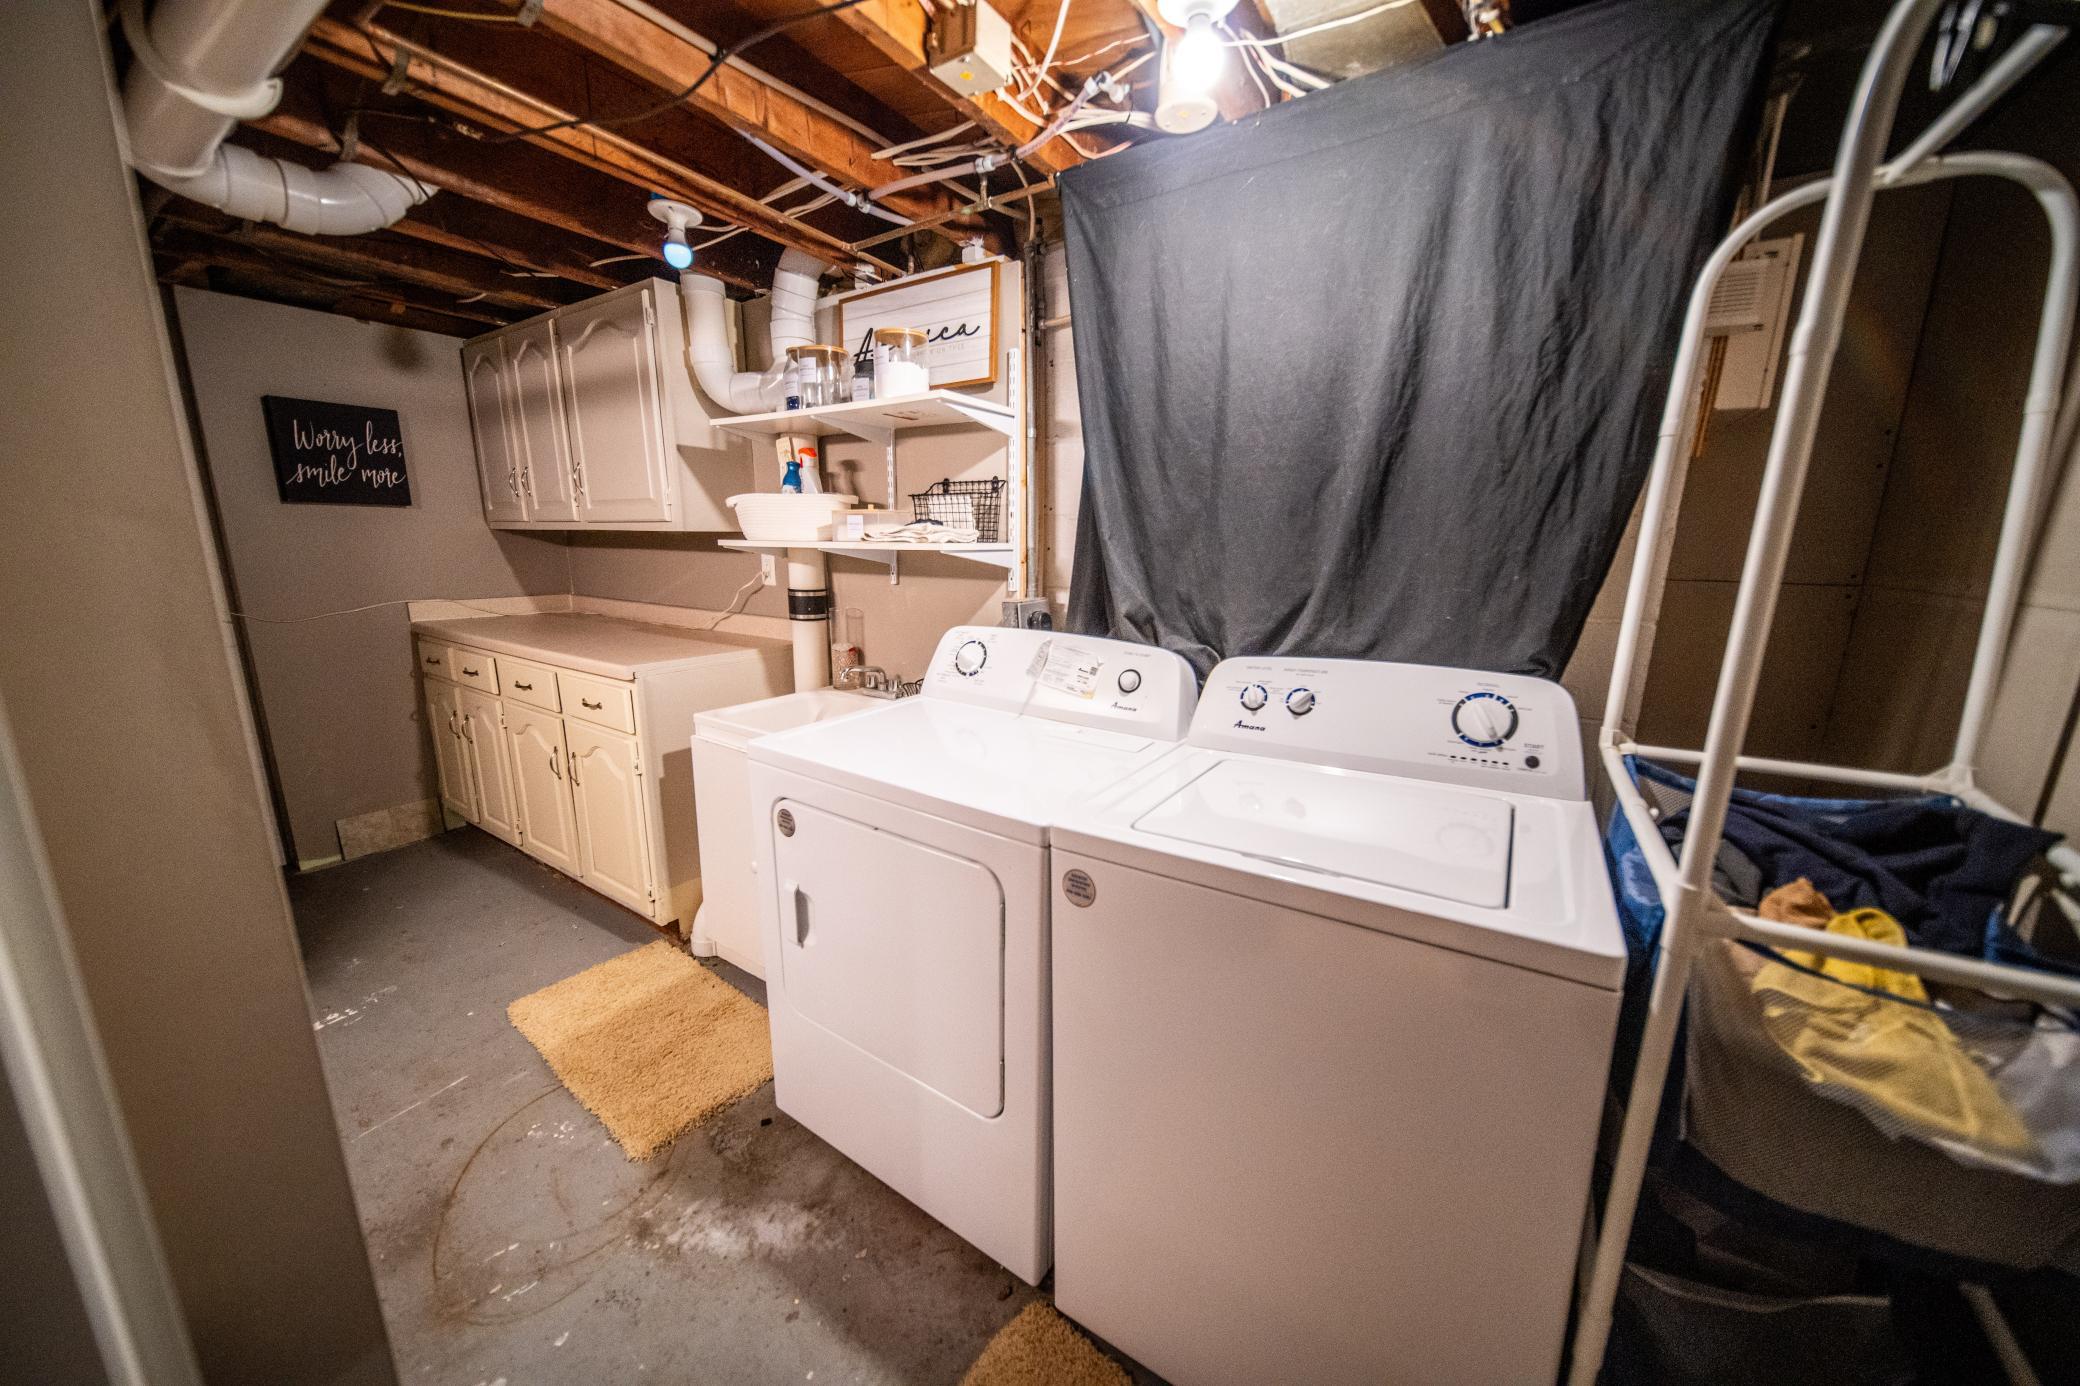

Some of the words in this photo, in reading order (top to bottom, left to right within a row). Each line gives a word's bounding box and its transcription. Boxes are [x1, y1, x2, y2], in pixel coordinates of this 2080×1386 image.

[293, 418, 365, 470] Worry
[365, 420, 403, 458] less,
[286, 454, 352, 488] smile
[361, 468, 406, 488] more
[1111, 701, 1137, 712] Amana
[1233, 719, 1266, 732] Amana
